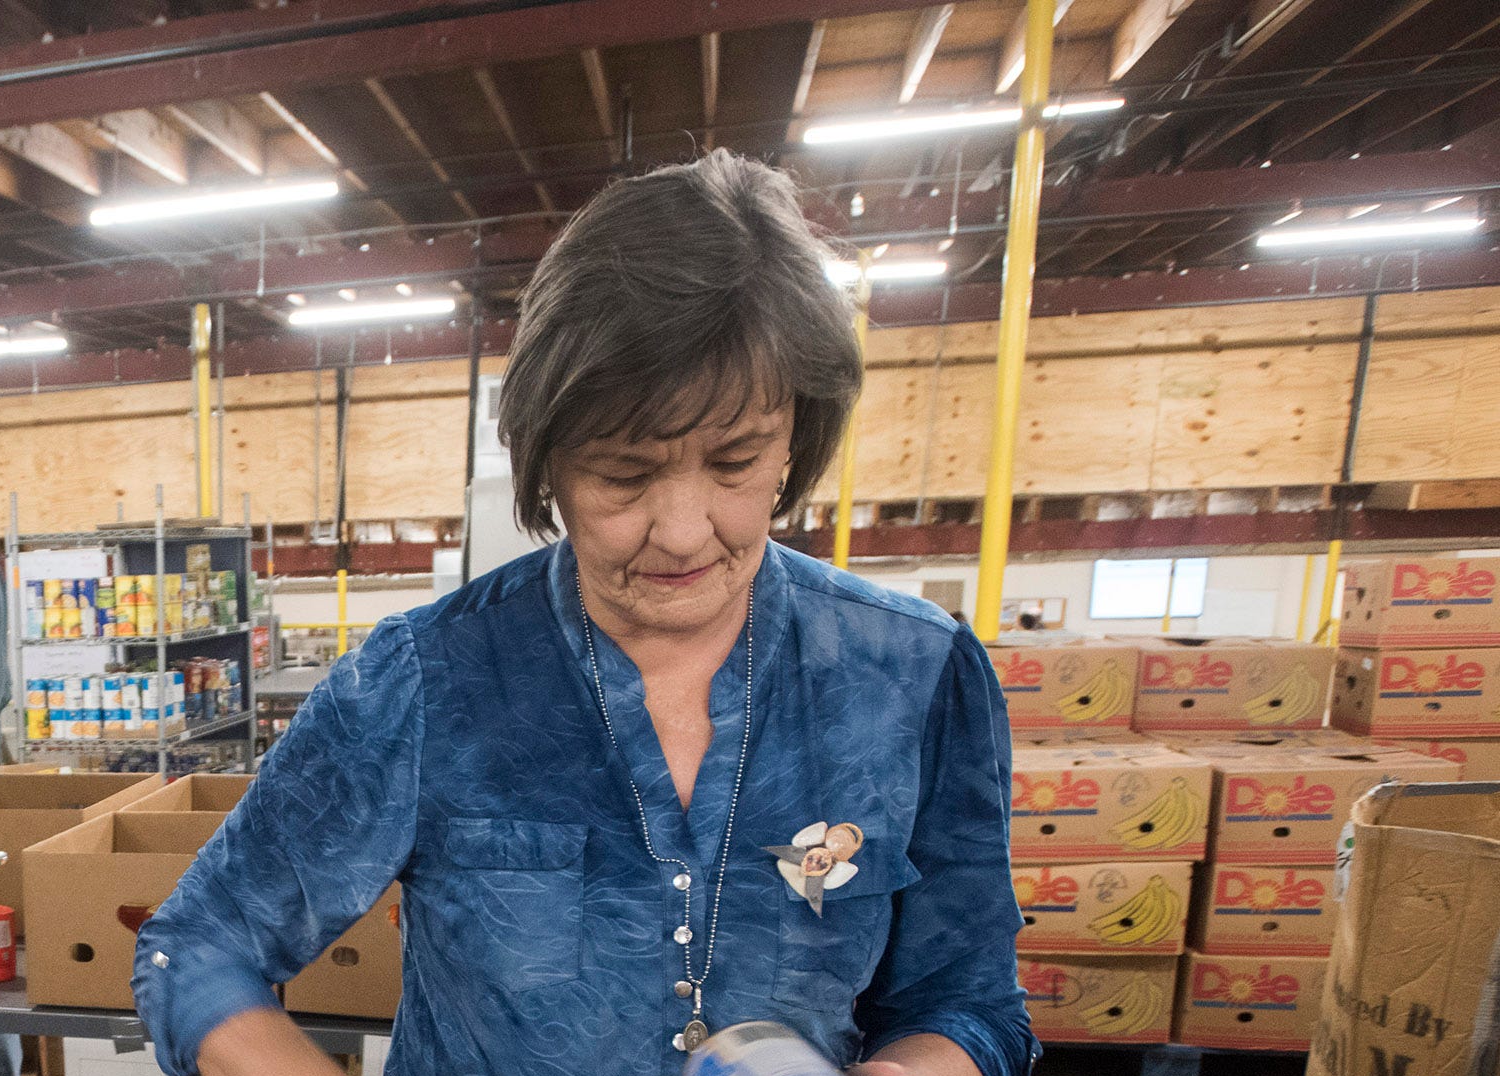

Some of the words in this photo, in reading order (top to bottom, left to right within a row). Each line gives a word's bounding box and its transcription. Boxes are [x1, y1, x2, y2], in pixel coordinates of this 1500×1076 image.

[1392, 562, 1496, 600] Dole
[1142, 654, 1233, 688] Dole
[1380, 654, 1485, 693] Dole
[1226, 776, 1336, 815] Dole
[1011, 867, 1080, 908] ole
[1215, 869, 1325, 910] Dole
[1192, 963, 1299, 1004] Dole
[1404, 1003, 1452, 1044] By
